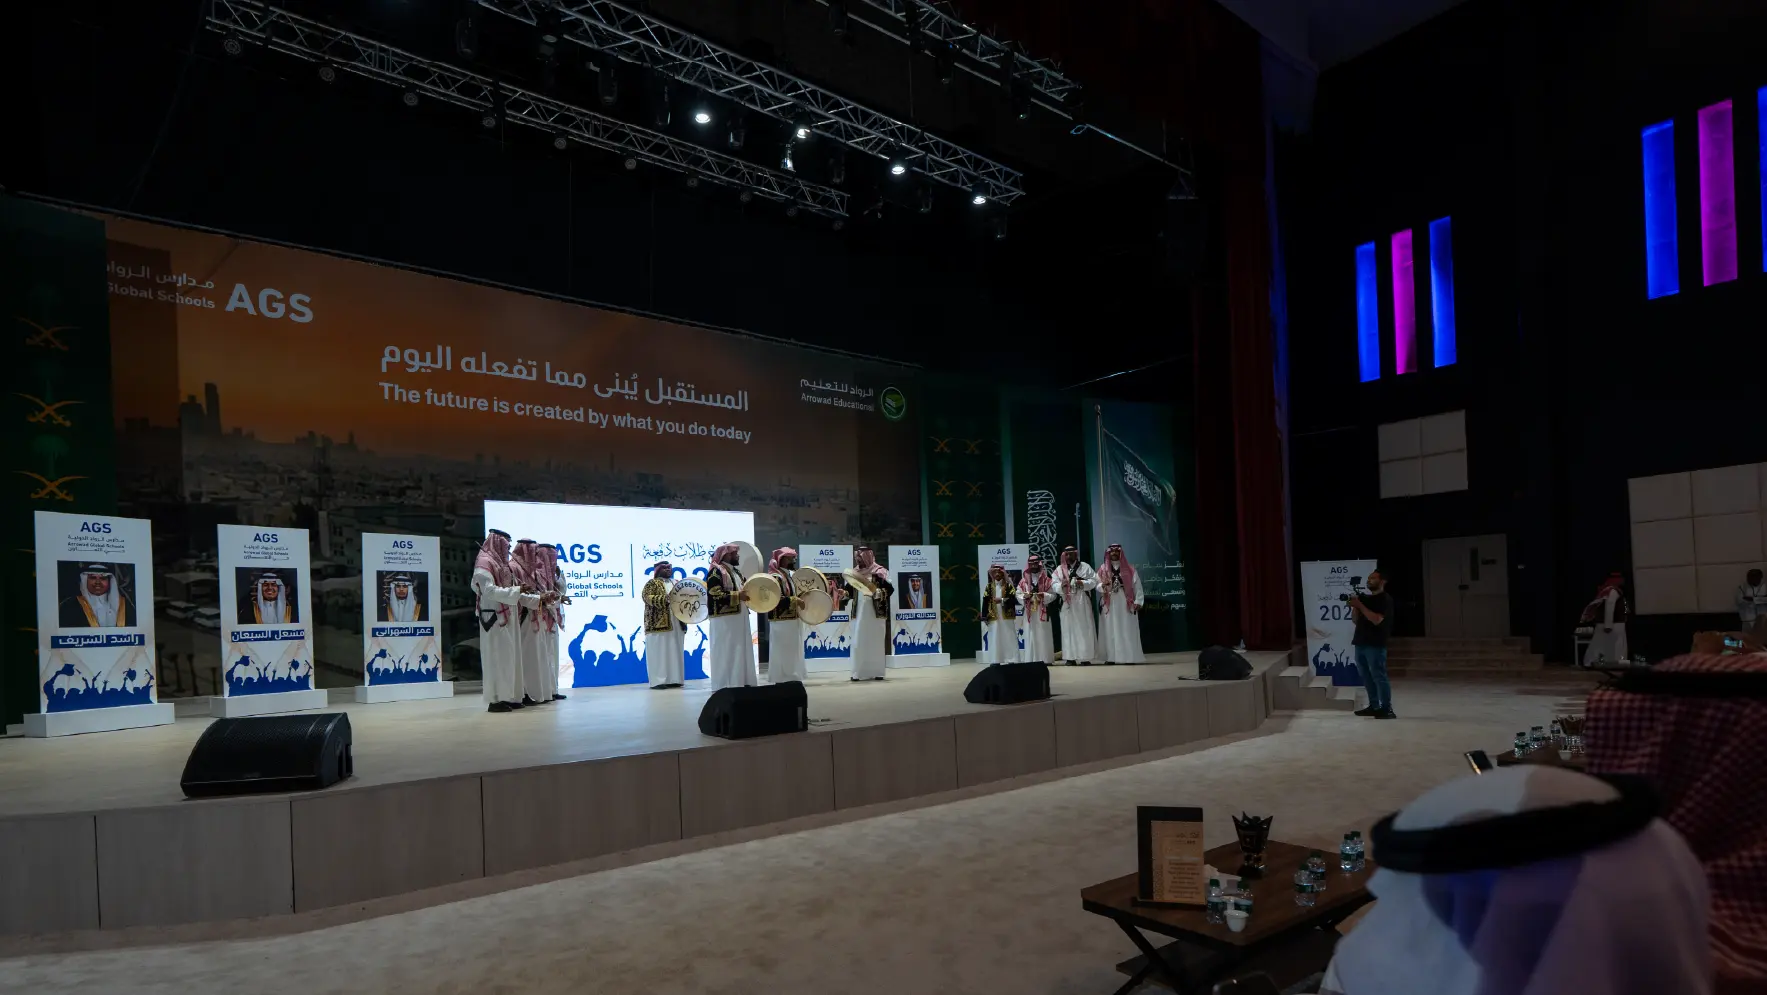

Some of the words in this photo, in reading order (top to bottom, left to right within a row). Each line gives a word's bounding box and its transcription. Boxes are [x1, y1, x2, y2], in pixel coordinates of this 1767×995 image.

[157, 290, 215, 309] Schools
[225, 283, 314, 323] AGS
[381, 345, 451, 372] اليوم
[460, 352, 537, 380] تفعله
[546, 362, 586, 388] مما
[645, 378, 748, 411] المستقبل
[850, 385, 874, 398] الرواد
[801, 393, 831, 404] Arrowad
[833, 398, 874, 412] Educational
[379, 382, 420, 403] The
[425, 388, 488, 411] future
[494, 397, 509, 414] is
[514, 402, 584, 423] created
[589, 408, 609, 428] by
[613, 413, 652, 430] what
[656, 420, 684, 434] you
[688, 422, 708, 436] do
[711, 424, 751, 444] today
[80, 522, 112, 533] AGS
[254, 533, 278, 543] AGS
[392, 540, 413, 549] AGS
[556, 543, 602, 563] AGS
[566, 570, 590, 579] الرواد
[594, 570, 623, 579] مدارس
[1320, 604, 1352, 621] 202
[59, 634, 106, 647] الشريف
